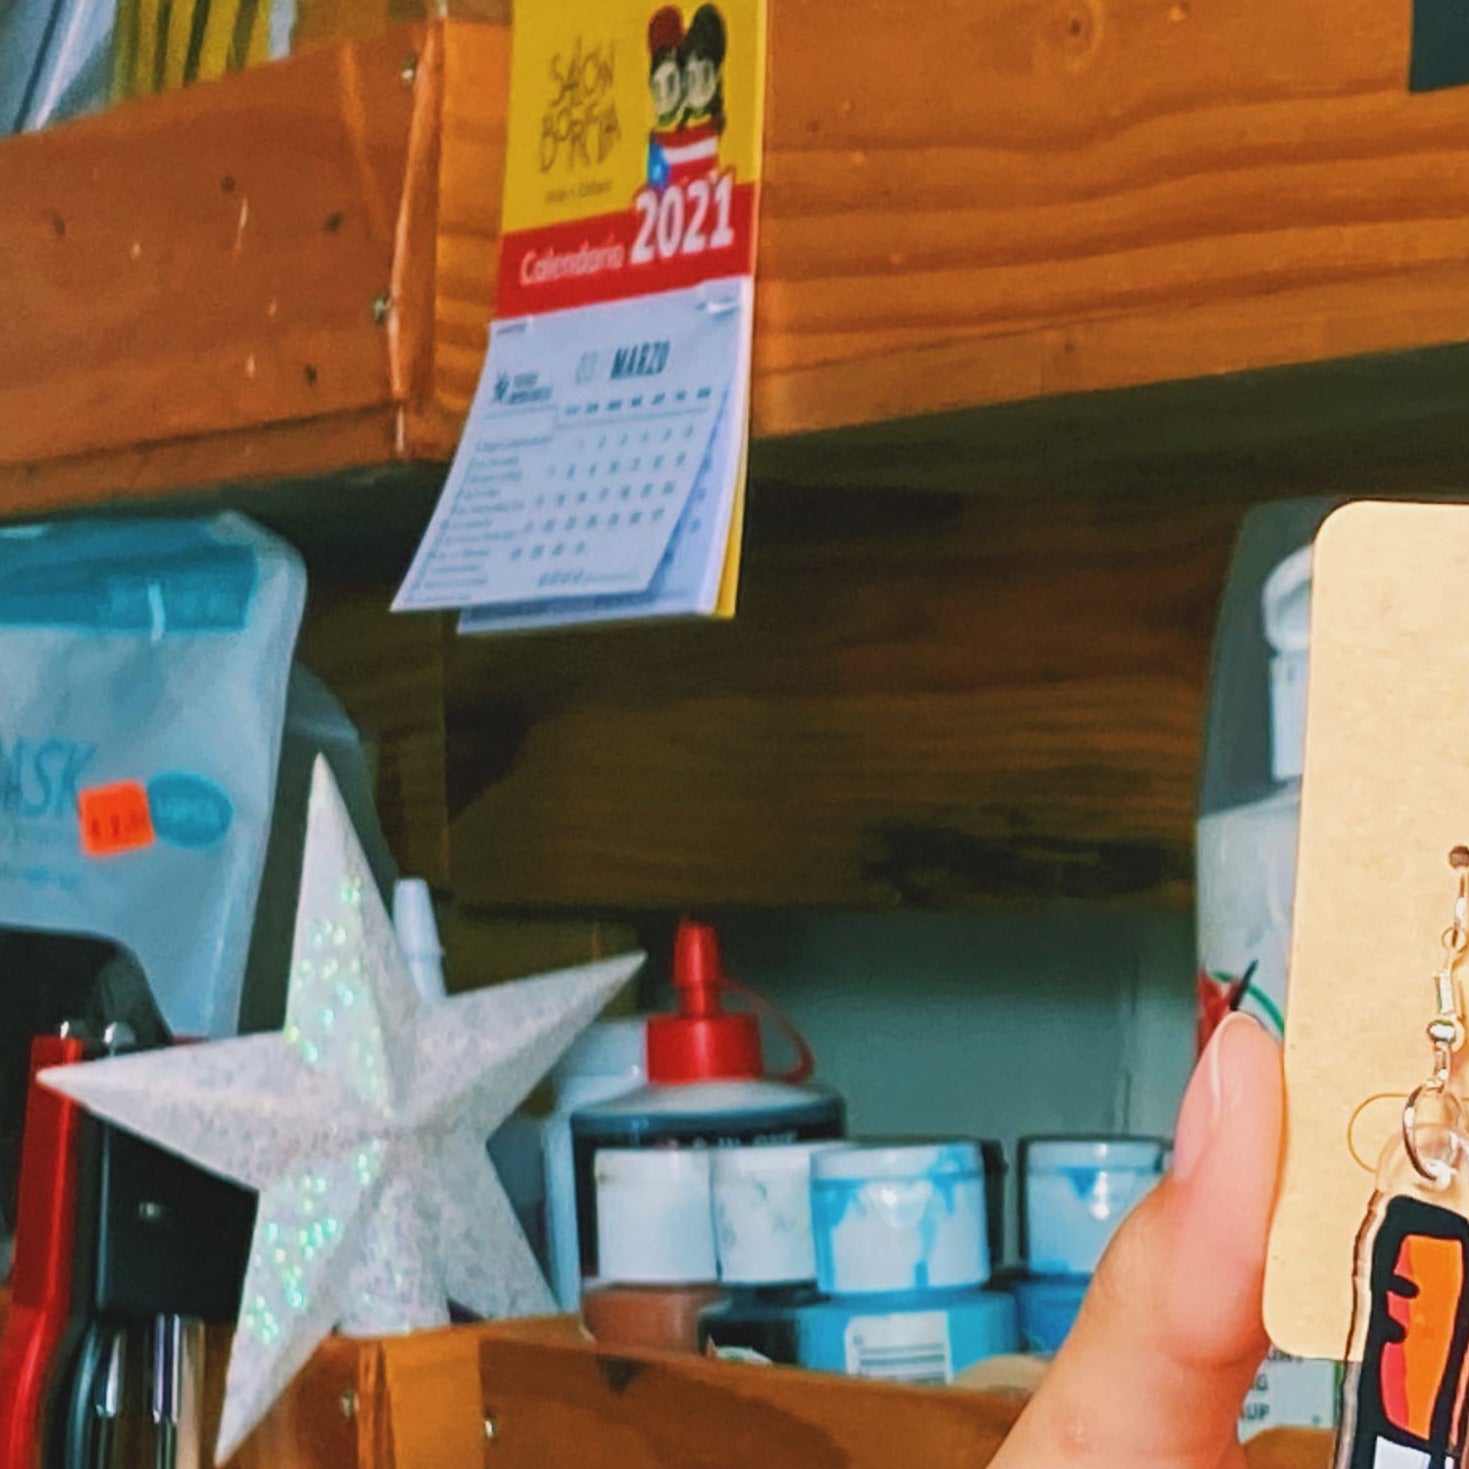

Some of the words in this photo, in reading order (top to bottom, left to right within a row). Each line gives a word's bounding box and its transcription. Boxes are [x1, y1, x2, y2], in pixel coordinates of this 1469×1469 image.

[520, 231, 625, 286] Calendario
[629, 170, 735, 265] 2021
[610, 339, 671, 380] MARZO
